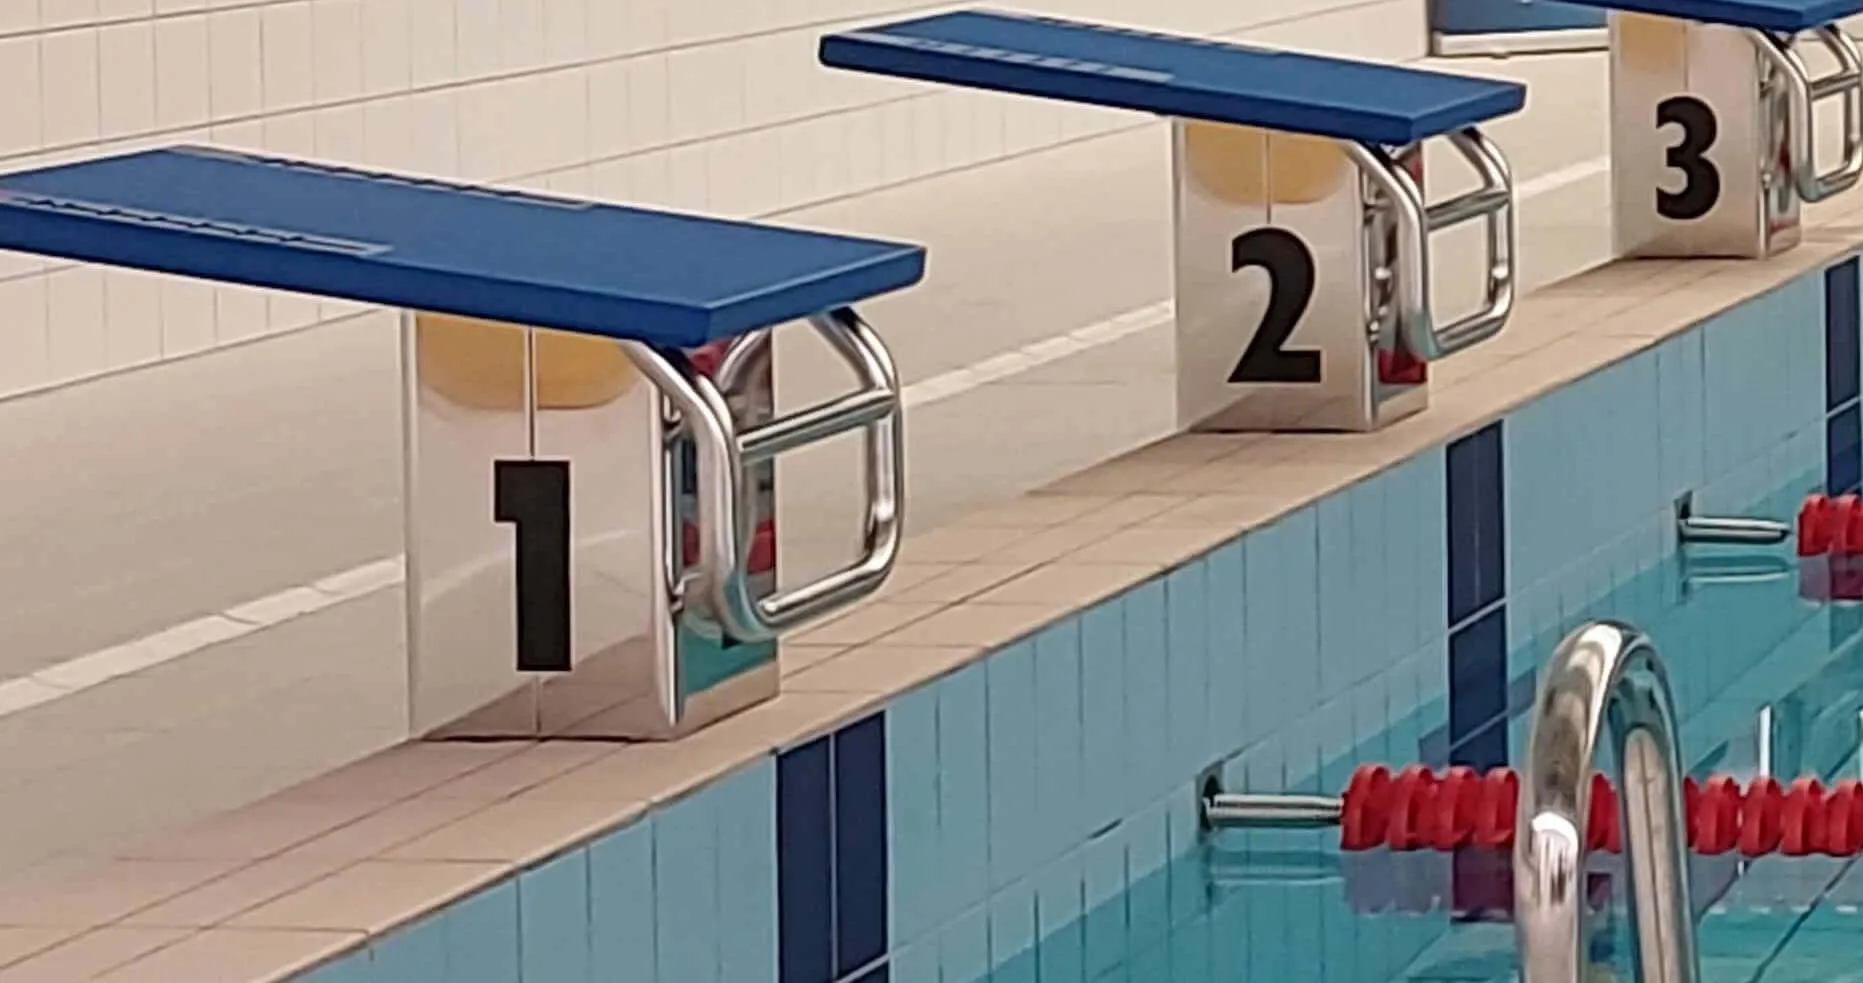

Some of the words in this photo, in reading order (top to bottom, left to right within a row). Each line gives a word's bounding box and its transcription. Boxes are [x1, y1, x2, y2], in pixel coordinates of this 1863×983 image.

[1656, 96, 1720, 219] 3
[1228, 227, 1321, 383] 2
[494, 460, 571, 671] 1
